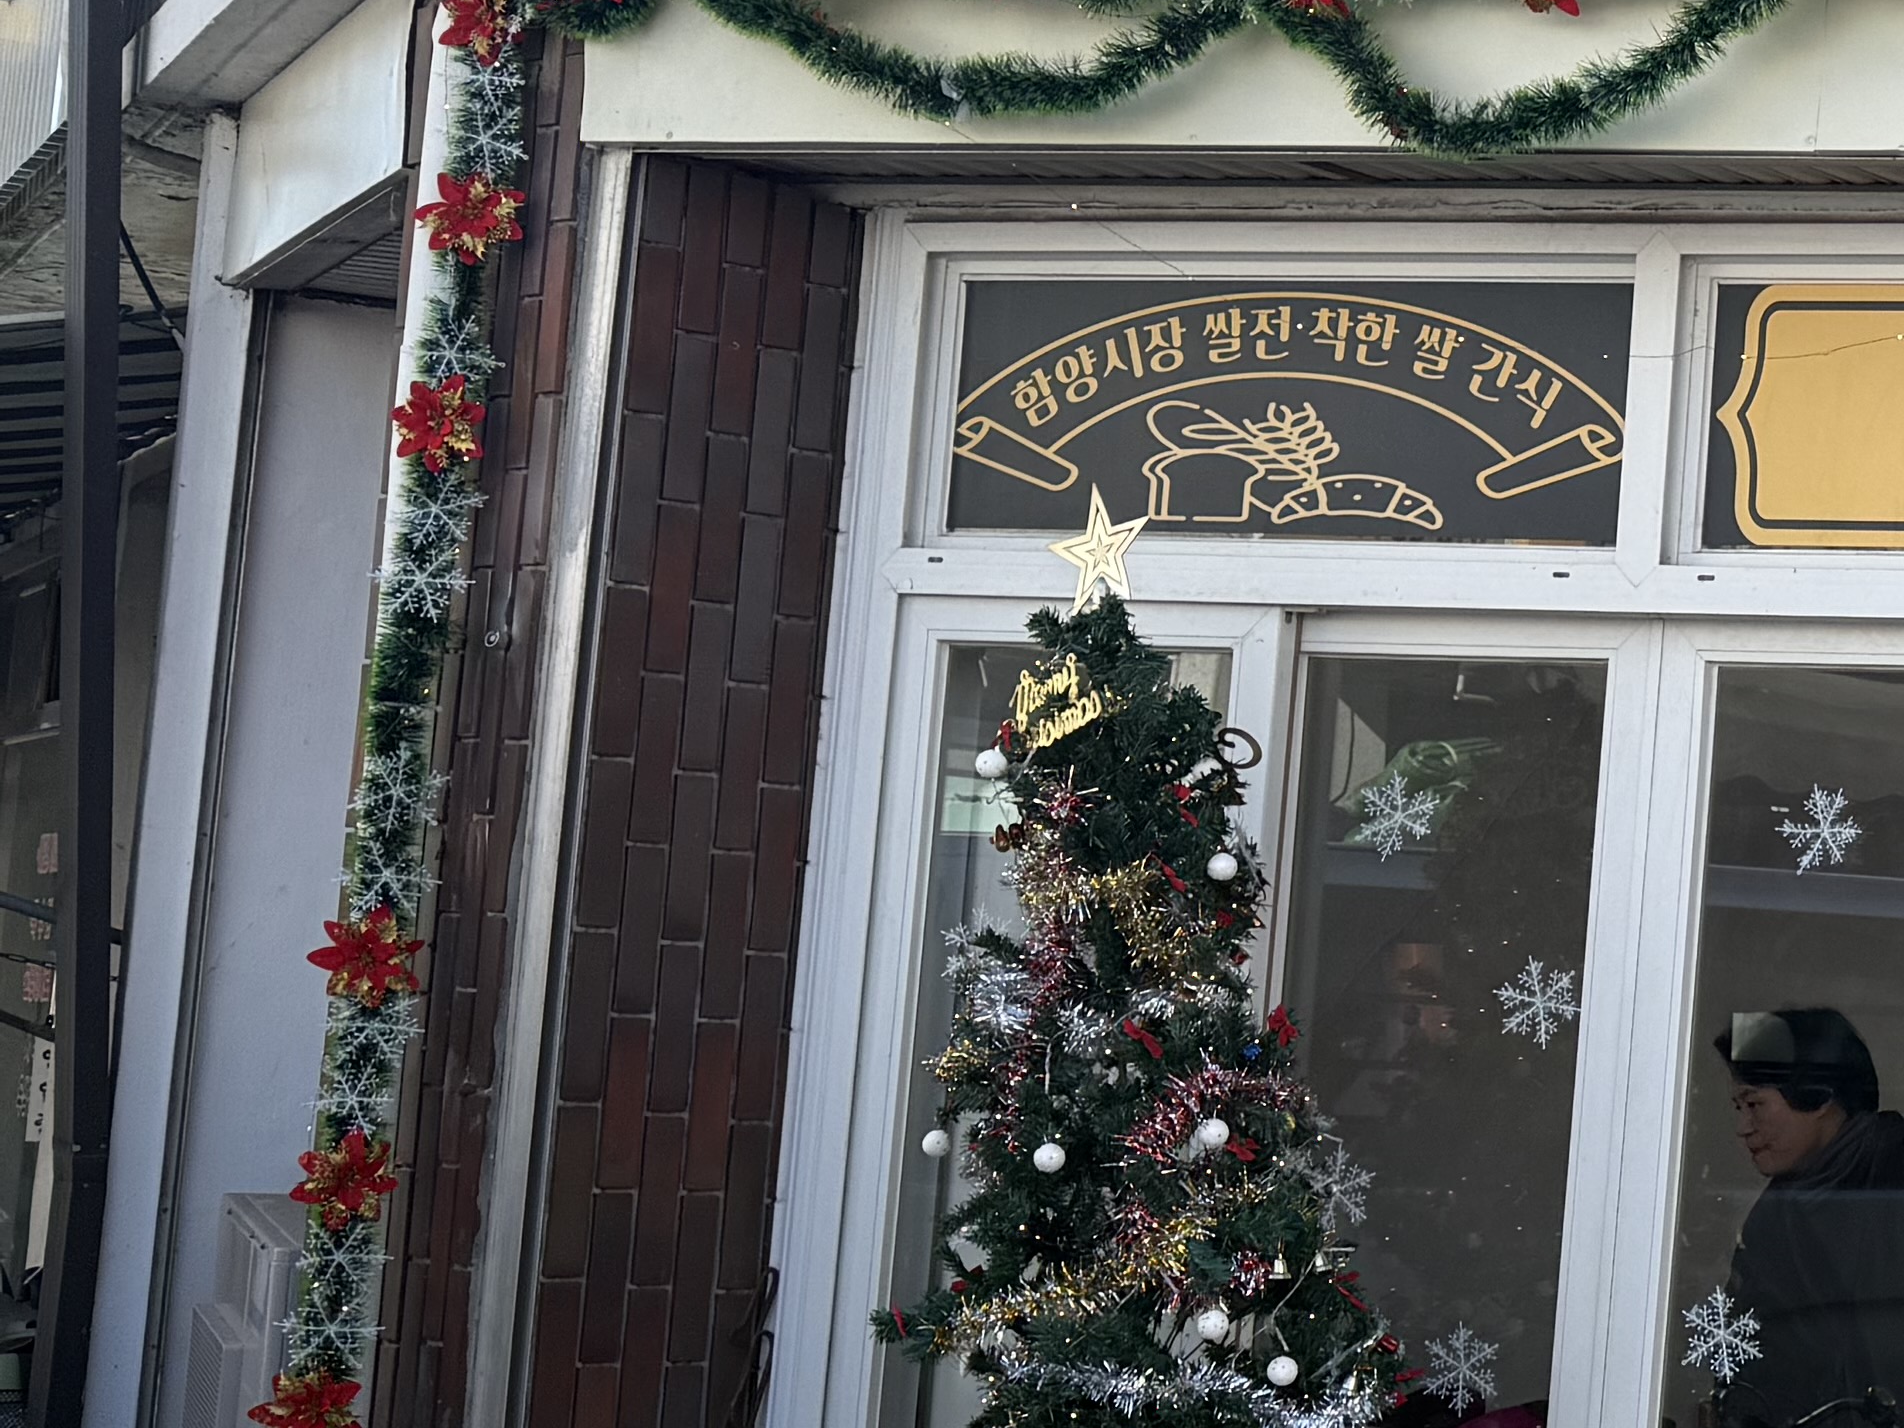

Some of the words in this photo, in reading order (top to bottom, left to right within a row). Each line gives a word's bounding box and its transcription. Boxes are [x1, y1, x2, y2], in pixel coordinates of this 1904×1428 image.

[1010, 316, 1186, 428] 함양시장
[1202, 305, 1293, 362] 쌀전
[1309, 306, 1400, 368] 착한
[1412, 326, 1462, 379] 쌀
[1470, 340, 1565, 430] 간식
